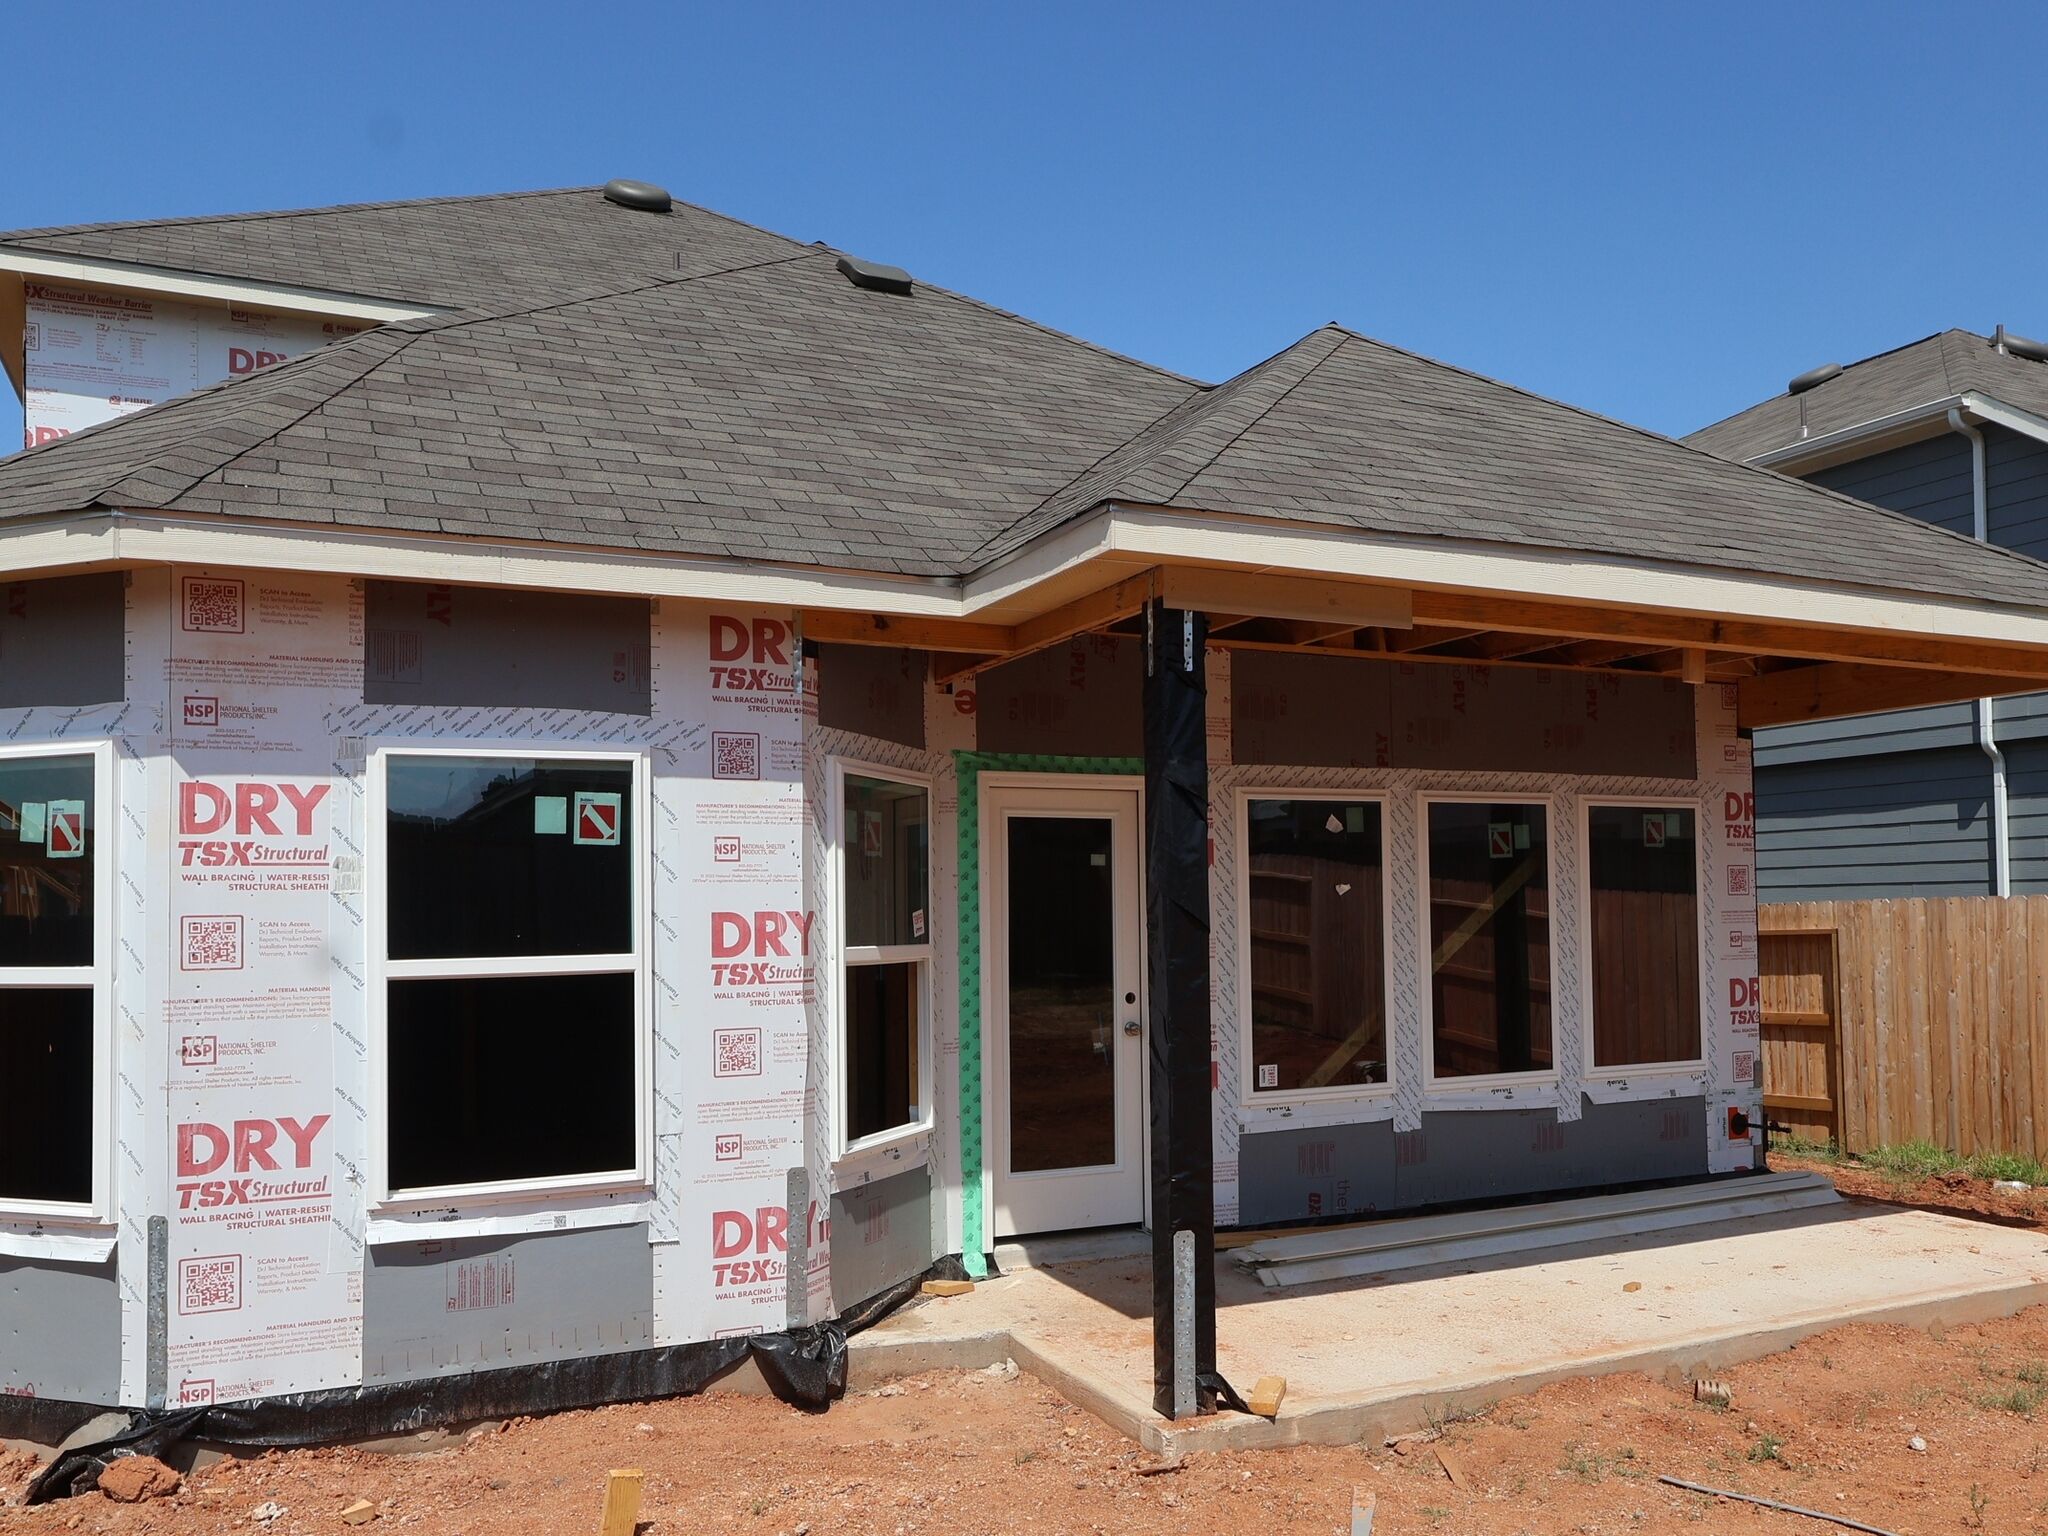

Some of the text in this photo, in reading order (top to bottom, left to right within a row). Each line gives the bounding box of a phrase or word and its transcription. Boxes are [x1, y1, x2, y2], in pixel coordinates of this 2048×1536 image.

[229, 348, 288, 374] DR
[710, 615, 793, 665] DR
[709, 667, 768, 690] TSX
[712, 695, 732, 703] WALL
[184, 705, 213, 718] NSP
[220, 705, 278, 714] NATIONAL SHELTER
[748, 705, 793, 713] STRUCTURAL
[179, 782, 331, 836] DRY
[178, 841, 327, 867] TSX Structural
[715, 843, 737, 855] NSP
[181, 874, 208, 882] WALL
[211, 874, 256, 882] BRACING
[228, 883, 288, 891] STRUCTURAL
[711, 911, 815, 958] DRY
[711, 963, 769, 986] TSX
[736, 990, 770, 998] BRACING
[177, 1114, 331, 1177] DRY
[716, 1142, 738, 1153] NSP
[176, 1176, 327, 1209] TSX Structural
[179, 1215, 206, 1225] WALL
[209, 1212, 254, 1222] BRACING
[227, 1219, 286, 1230] STRUCTURAL
[712, 1259, 771, 1287] TSX
[715, 1288, 772, 1300] WALL BRACING
[298, 1319, 331, 1327] HANDLING
[216, 1379, 274, 1393] NATIONAL SHELTER
[180, 1388, 209, 1403] NSP
